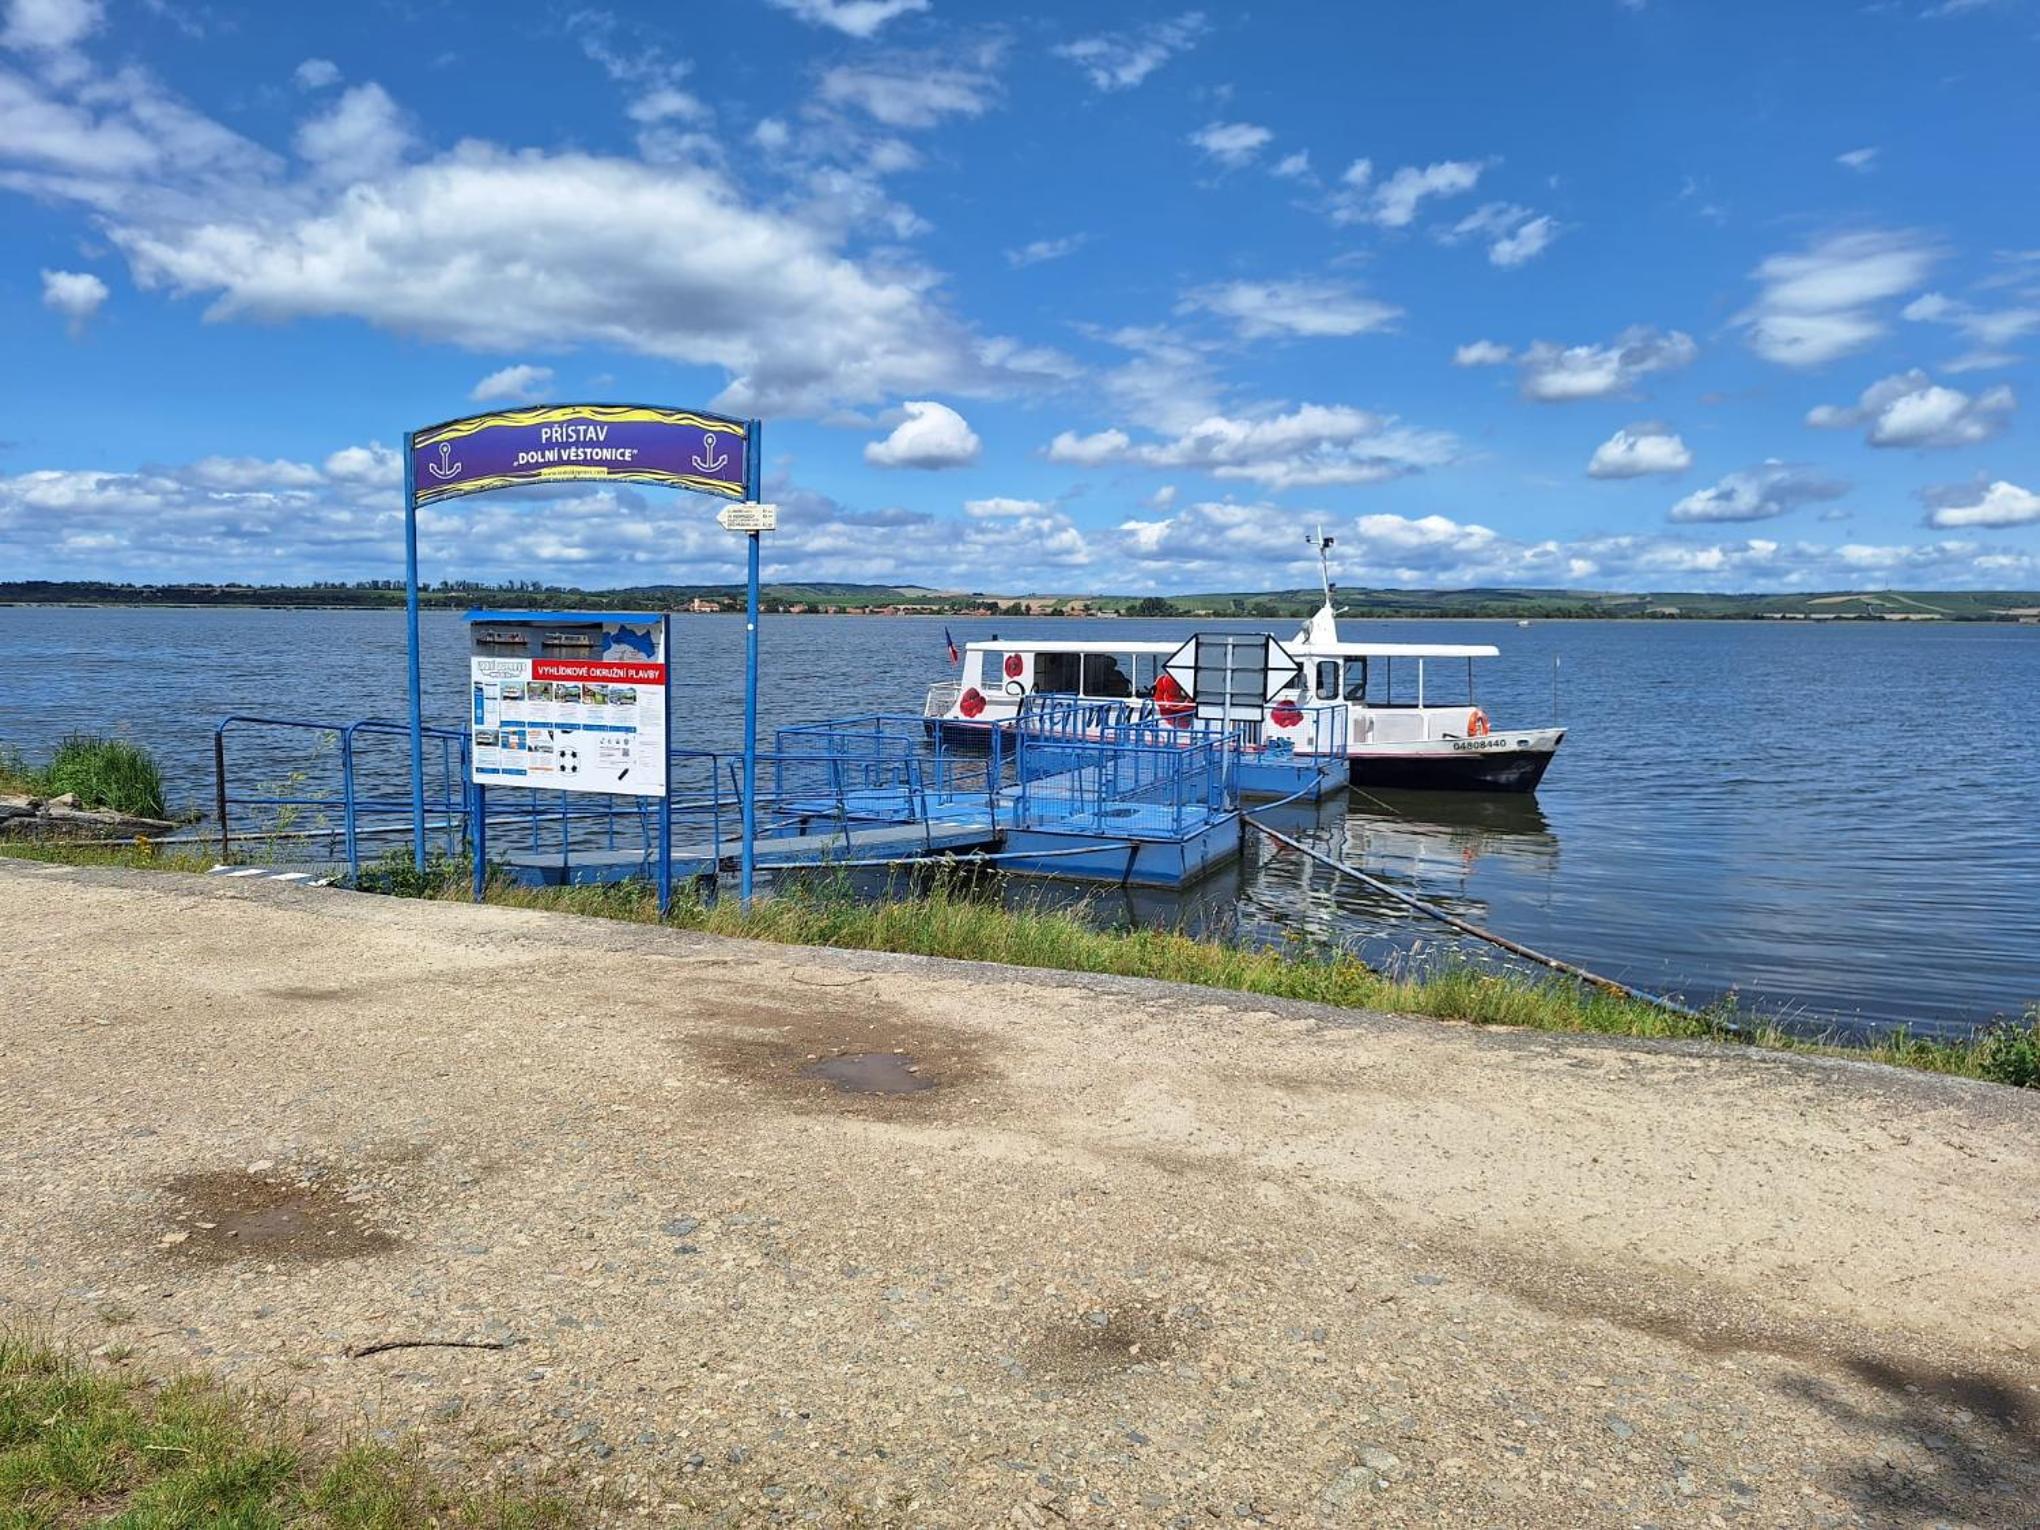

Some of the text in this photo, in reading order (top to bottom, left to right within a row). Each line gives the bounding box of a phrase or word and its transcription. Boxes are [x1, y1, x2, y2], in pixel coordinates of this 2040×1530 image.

[541, 423, 608, 444] PŘÍSTAV
[537, 665, 589, 677] VYHLÍDKOVÉ
[628, 669, 660, 680] PLAVBY
